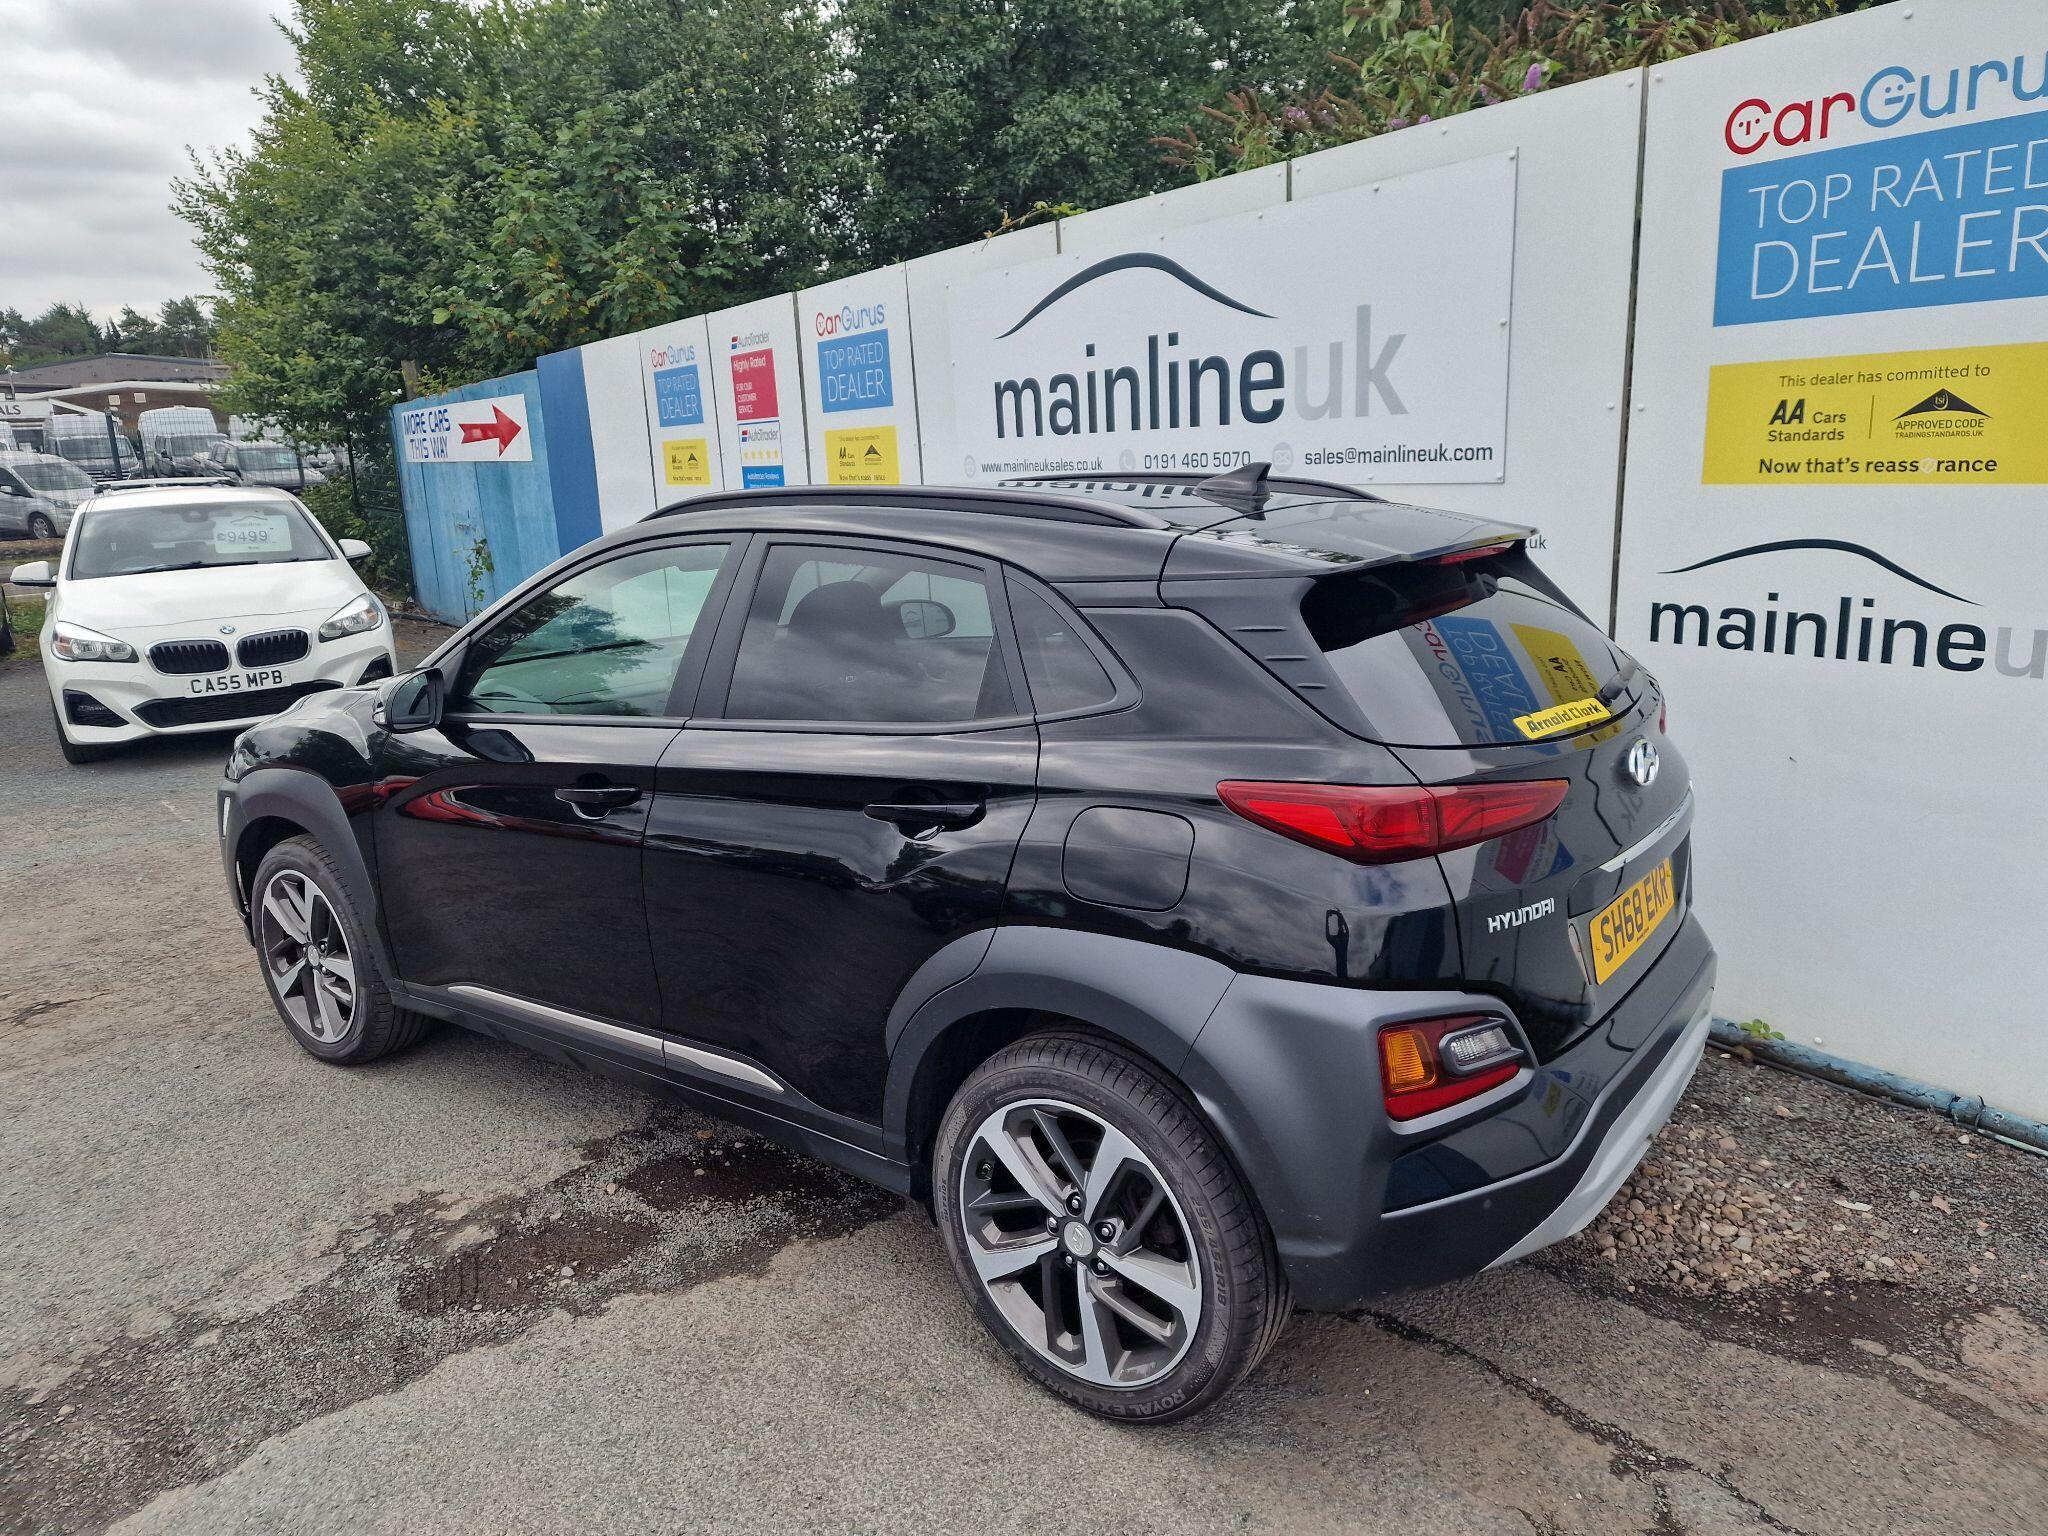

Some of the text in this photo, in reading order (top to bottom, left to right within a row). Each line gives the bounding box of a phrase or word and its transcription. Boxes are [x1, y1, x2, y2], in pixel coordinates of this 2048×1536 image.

[1748, 138, 2048, 229] TOP RATED
[1751, 204, 2048, 300] DEALER
[816, 304, 885, 336] CarGurus
[651, 345, 696, 368] CarGurus
[824, 341, 884, 369] TOP RATED
[994, 304, 1409, 439] mainlineuk
[1779, 365, 1991, 387] This dealer has committed to
[827, 368, 887, 402] DEALER
[661, 395, 699, 420] DEALER
[1768, 398, 1847, 425] AA Cars
[403, 408, 451, 436] MORE CARS
[1895, 430, 1984, 439] TRADINGSTANDARDS.UK
[1896, 418, 1985, 430] APPROVED CODE
[410, 436, 448, 459] THIS WAY
[1768, 428, 1845, 442] Standards
[981, 456, 1103, 473] www.mainlineuksales.co.uk
[1144, 450, 1250, 469] 0191 460 5070
[1304, 443, 1493, 465] sales@mainlineuk.com
[1759, 458, 1801, 474] Now
[1806, 457, 1860, 473] that's
[190, 670, 283, 694] CA55 MPB
[1527, 702, 1601, 733] Arnold Clark
[1487, 897, 1555, 934] HYUNDAI
[1600, 862, 1669, 962] SH68 EKR
